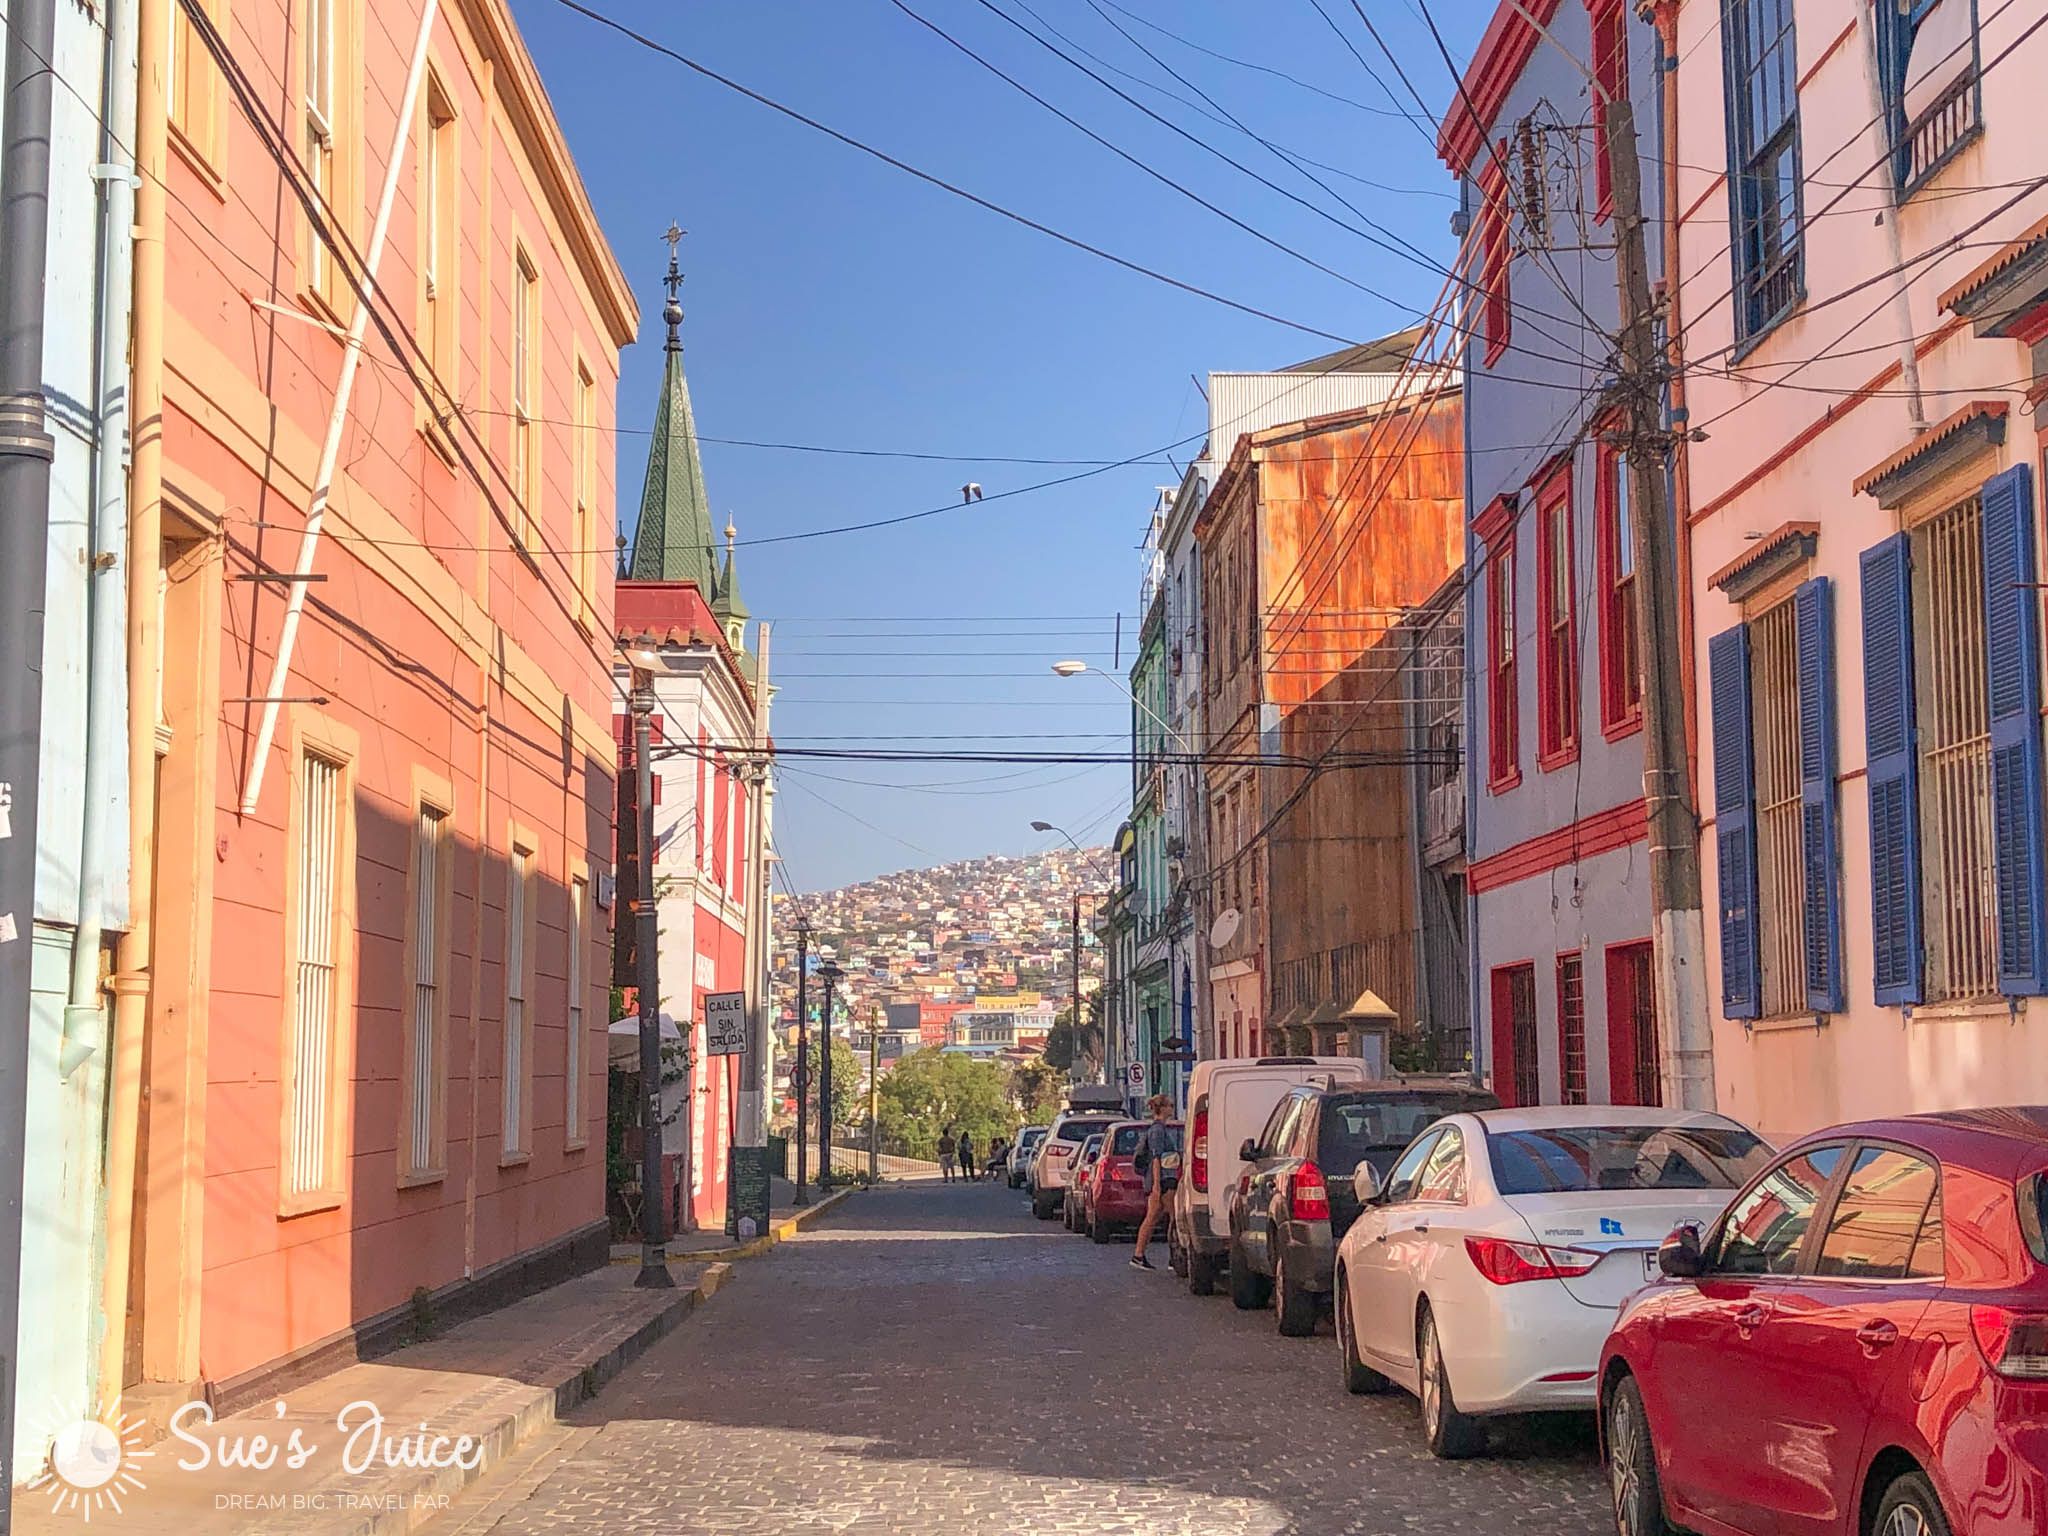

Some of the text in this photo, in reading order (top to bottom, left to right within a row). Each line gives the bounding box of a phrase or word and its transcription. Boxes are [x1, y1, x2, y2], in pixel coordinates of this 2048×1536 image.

[709, 1000, 740, 1012] CALLE
[718, 1018, 734, 1030] SIN
[709, 1034, 744, 1046] SALIDA
